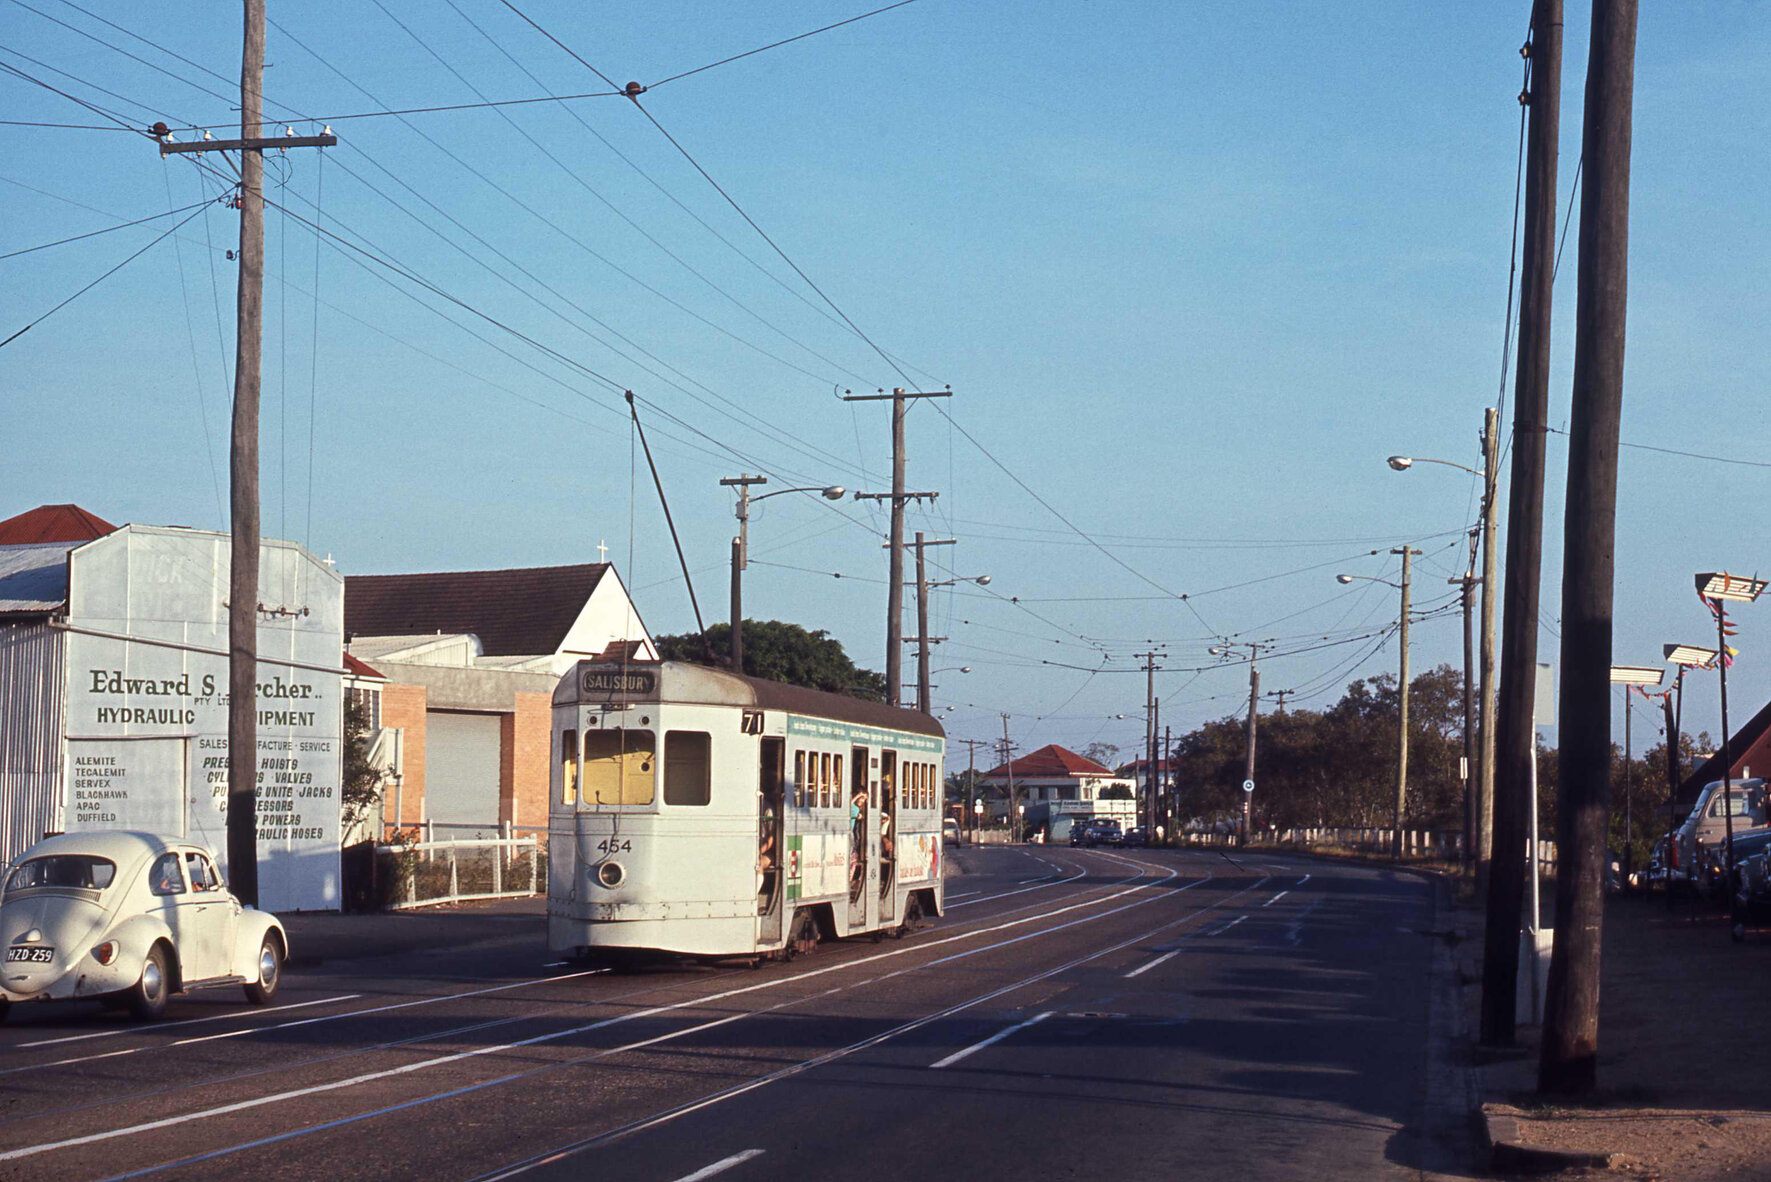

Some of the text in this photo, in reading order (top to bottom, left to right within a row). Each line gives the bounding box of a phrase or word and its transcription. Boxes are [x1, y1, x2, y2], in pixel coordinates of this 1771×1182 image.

[89, 669, 192, 696] Edward
[201, 674, 221, 697] S.
[586, 674, 650, 690] SALISBURY
[194, 698, 211, 706] PTY
[97, 707, 316, 726] HYDRAULIC IPMENT
[744, 713, 762, 733] 71
[199, 738, 228, 749] SALES
[299, 742, 331, 752] SERVICE
[75, 756, 116, 766] ALEMITE
[261, 758, 298, 771] HOISTS
[75, 767, 126, 777] TECALEMIT
[275, 772, 313, 785] VALVES
[75, 778, 111, 788] SERVEX
[76, 790, 128, 800] BLACKHAWK
[265, 786, 293, 798] UNITS
[298, 786, 333, 798] JACKS
[76, 801, 101, 811] APAC
[77, 812, 117, 822] DUFFIELD
[262, 813, 302, 826] POWERS
[291, 827, 324, 840] HOSES
[597, 839, 632, 853] 454
